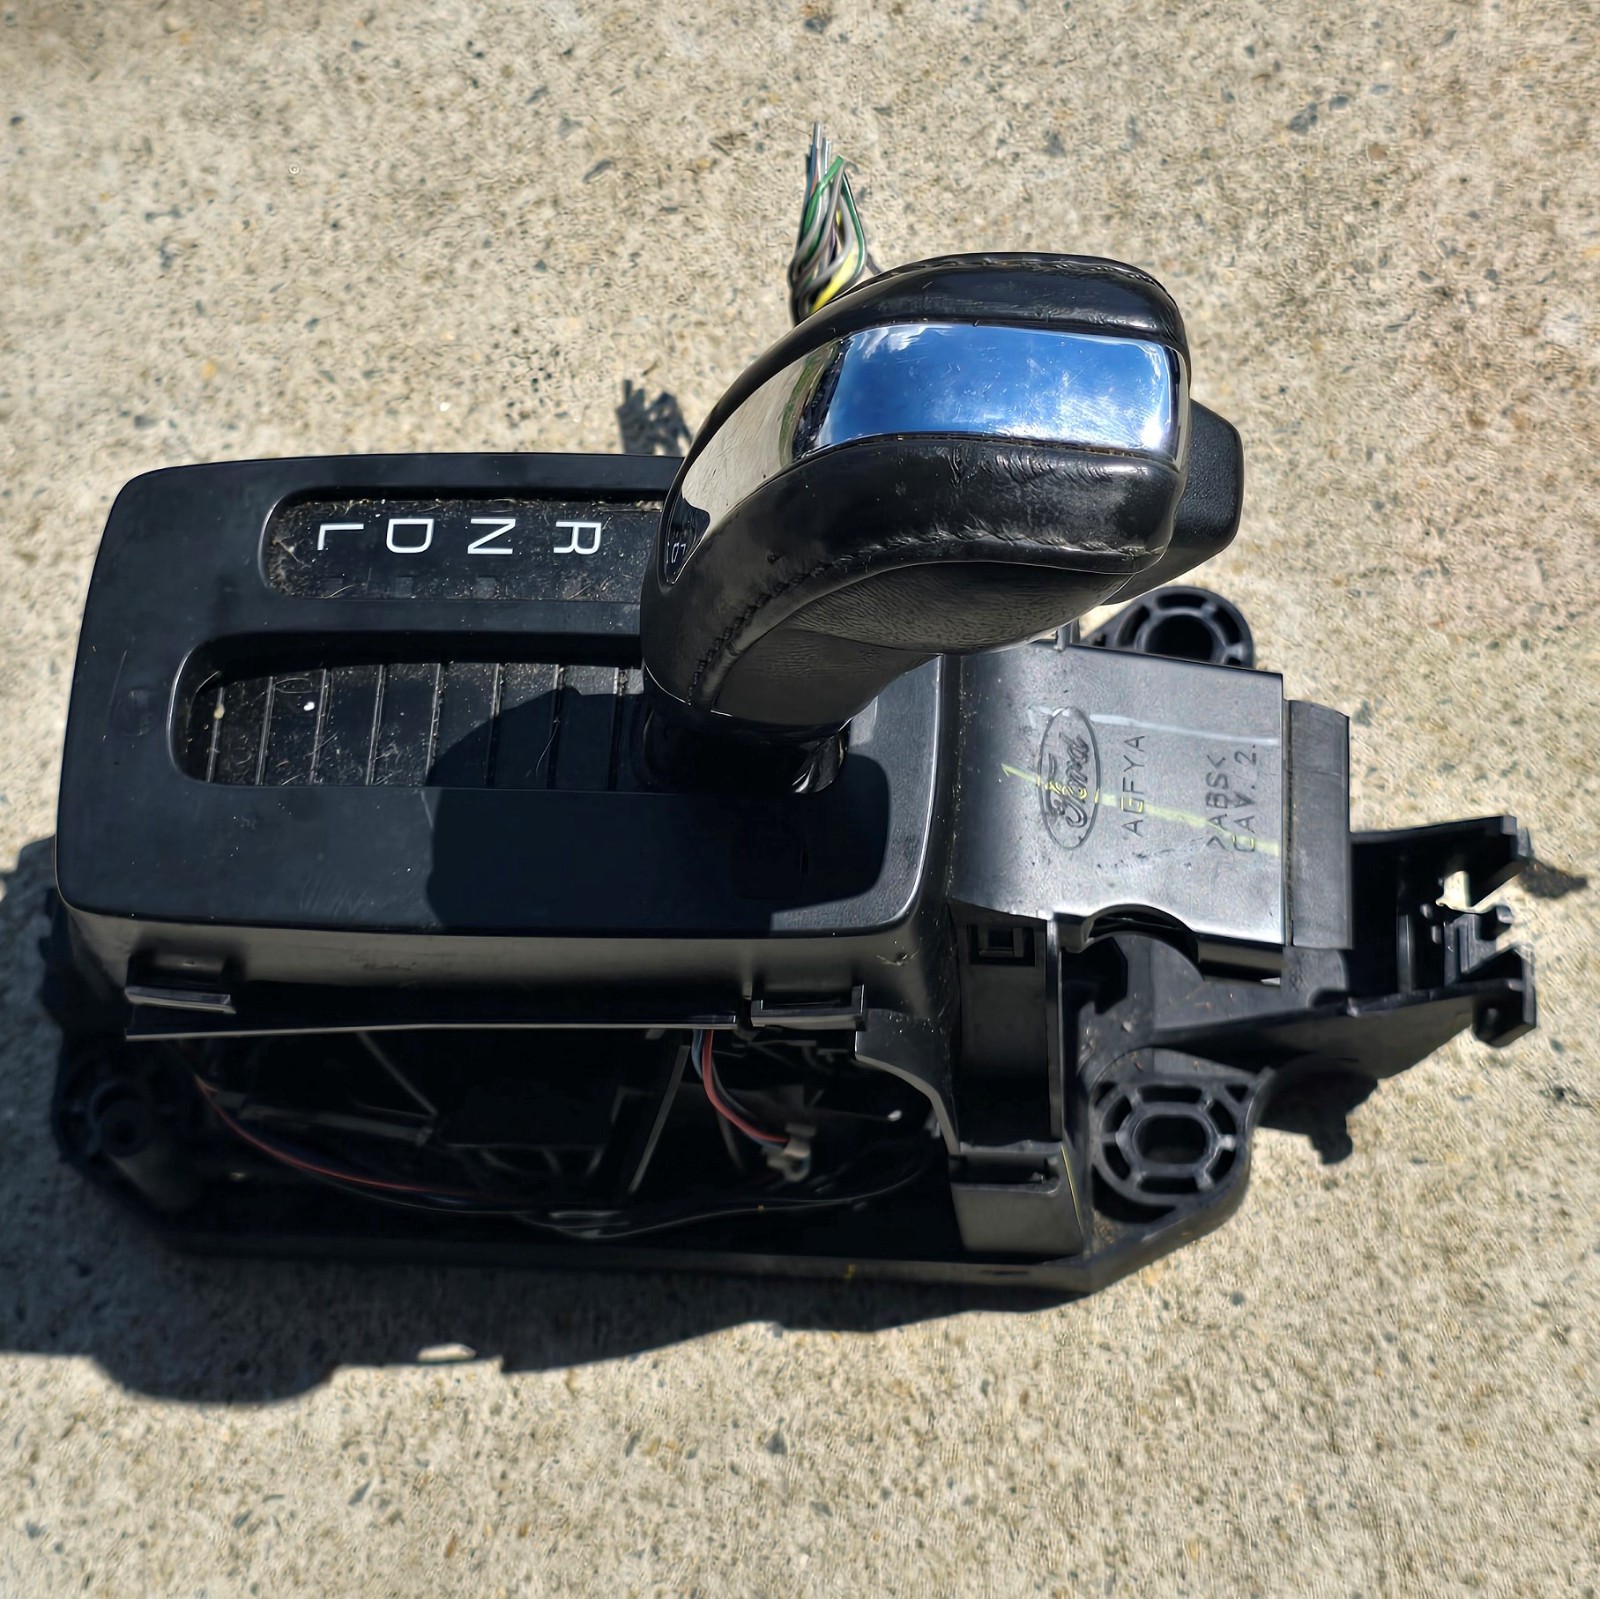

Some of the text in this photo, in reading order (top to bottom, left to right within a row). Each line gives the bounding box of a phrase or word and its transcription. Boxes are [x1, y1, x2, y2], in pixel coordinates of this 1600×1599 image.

[317, 523, 364, 551] L
[387, 519, 433, 554] D
[468, 519, 516, 555] N
[553, 521, 602, 555] R
[1043, 731, 1088, 829] Ford
[1120, 735, 1145, 838] AGFYA
